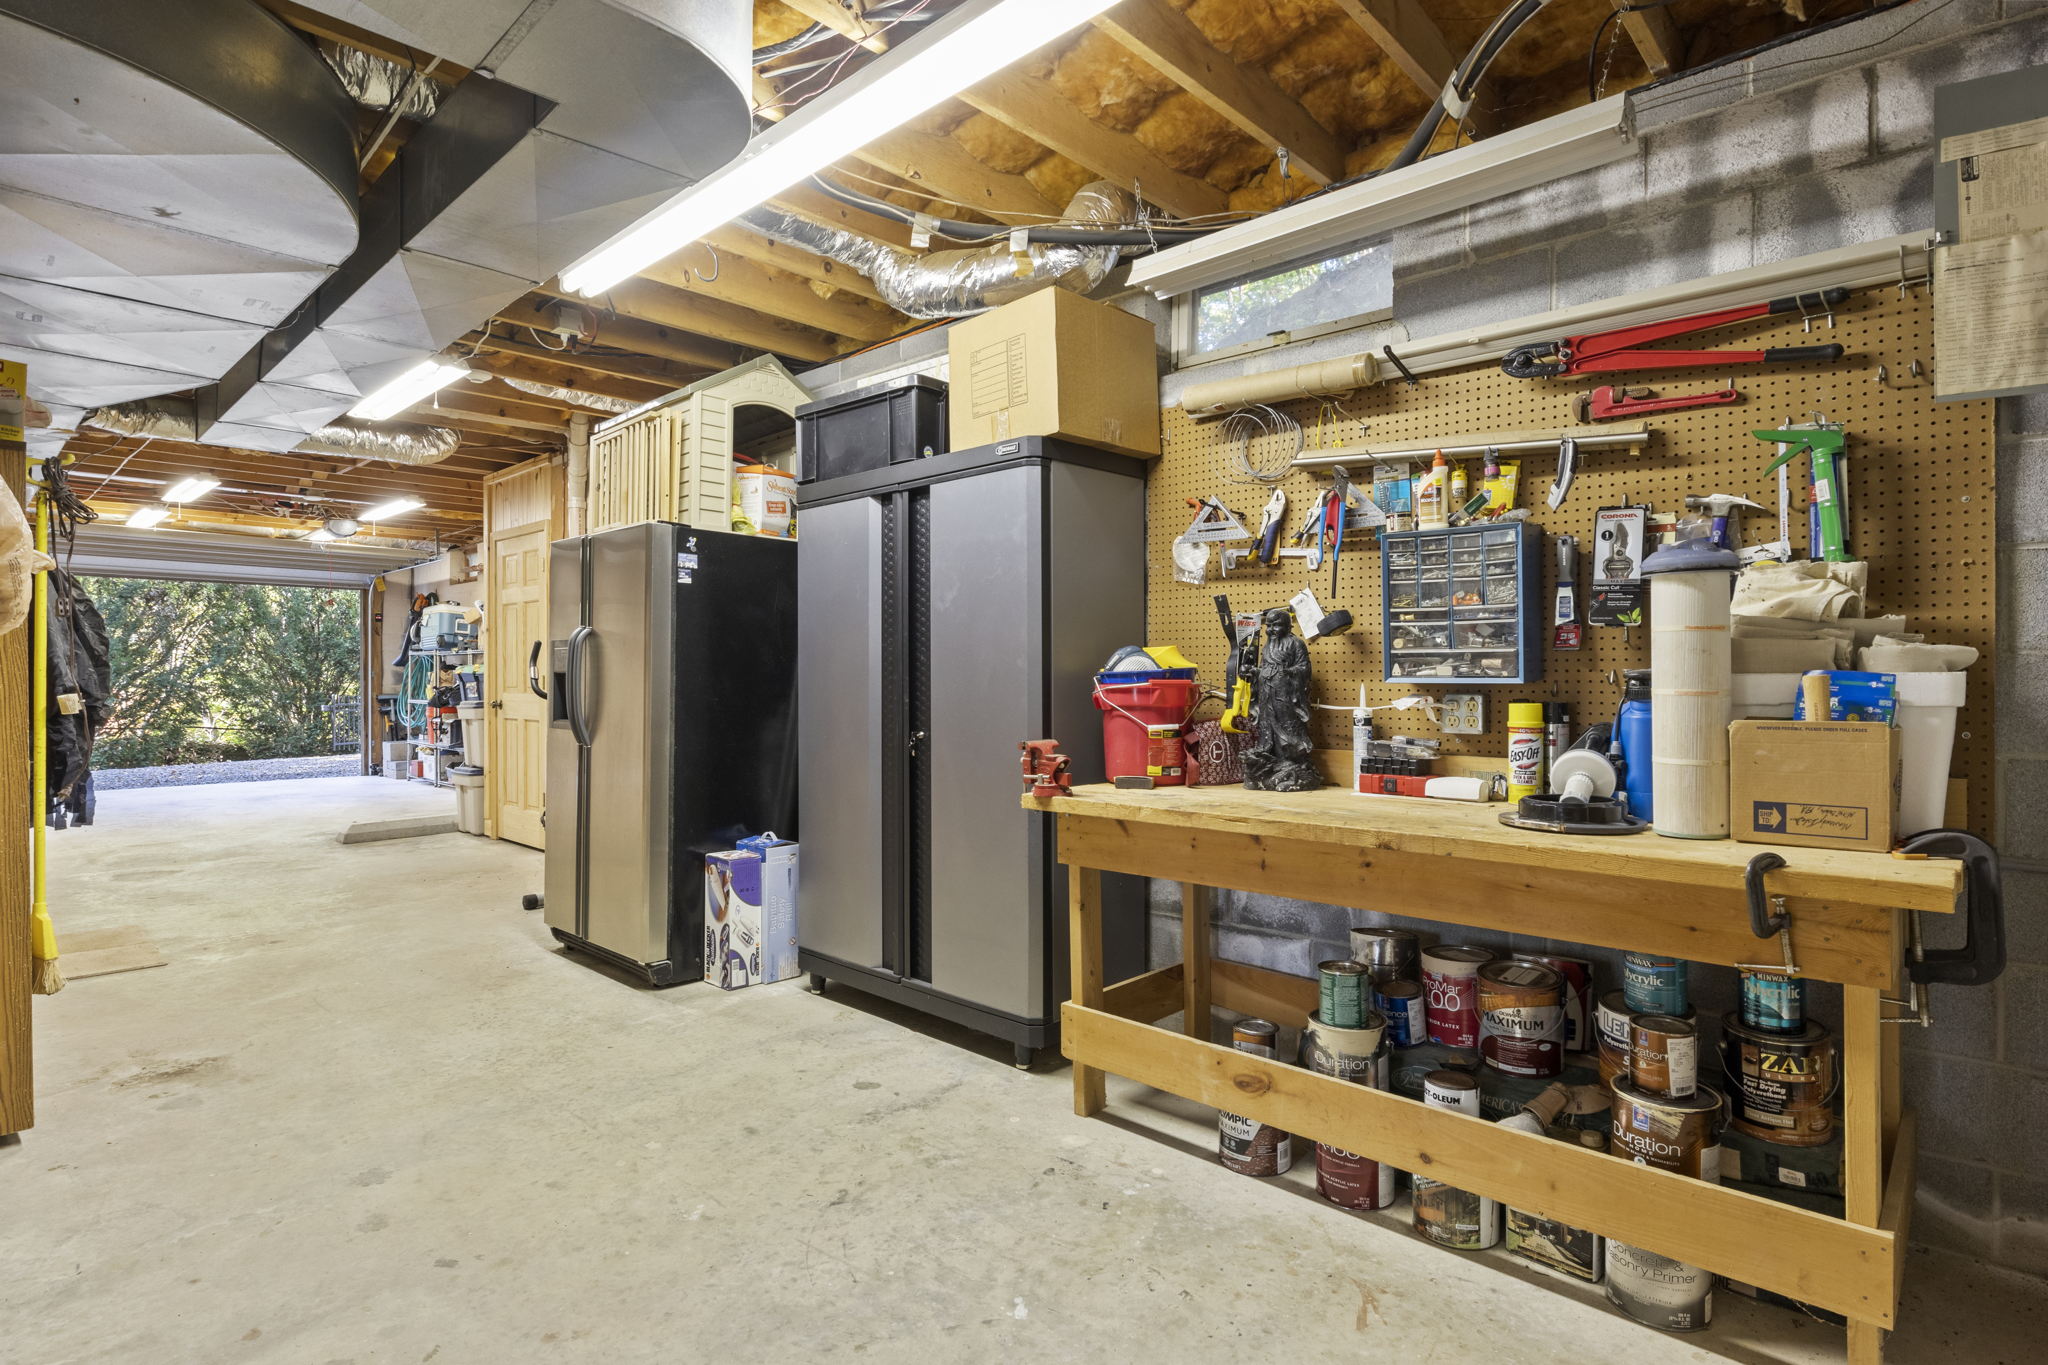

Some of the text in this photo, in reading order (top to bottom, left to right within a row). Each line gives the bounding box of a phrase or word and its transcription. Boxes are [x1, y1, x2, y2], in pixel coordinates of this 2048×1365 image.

[1510, 747, 1540, 762] EASY-OFF
[1423, 976, 1460, 993] ProMar
[1756, 973, 1789, 983] MINWAX
[1744, 980, 1800, 999] Polycrylic
[1442, 1022, 1460, 1030] LATEX
[1483, 1010, 1544, 1031] MAXIMUM
[1314, 1050, 1370, 1070] Duration
[1765, 1073, 1816, 1081] ULTRA
[1744, 1086, 1787, 1100] Polyurethane
[1759, 1083, 1786, 1094] Drying
[1613, 1120, 1680, 1157] Duration
[1629, 1144, 1654, 1156] HOME
[1609, 1249, 1649, 1276] asonry
[1653, 1269, 1696, 1284] Primer
[1673, 1261, 1684, 1272] &
